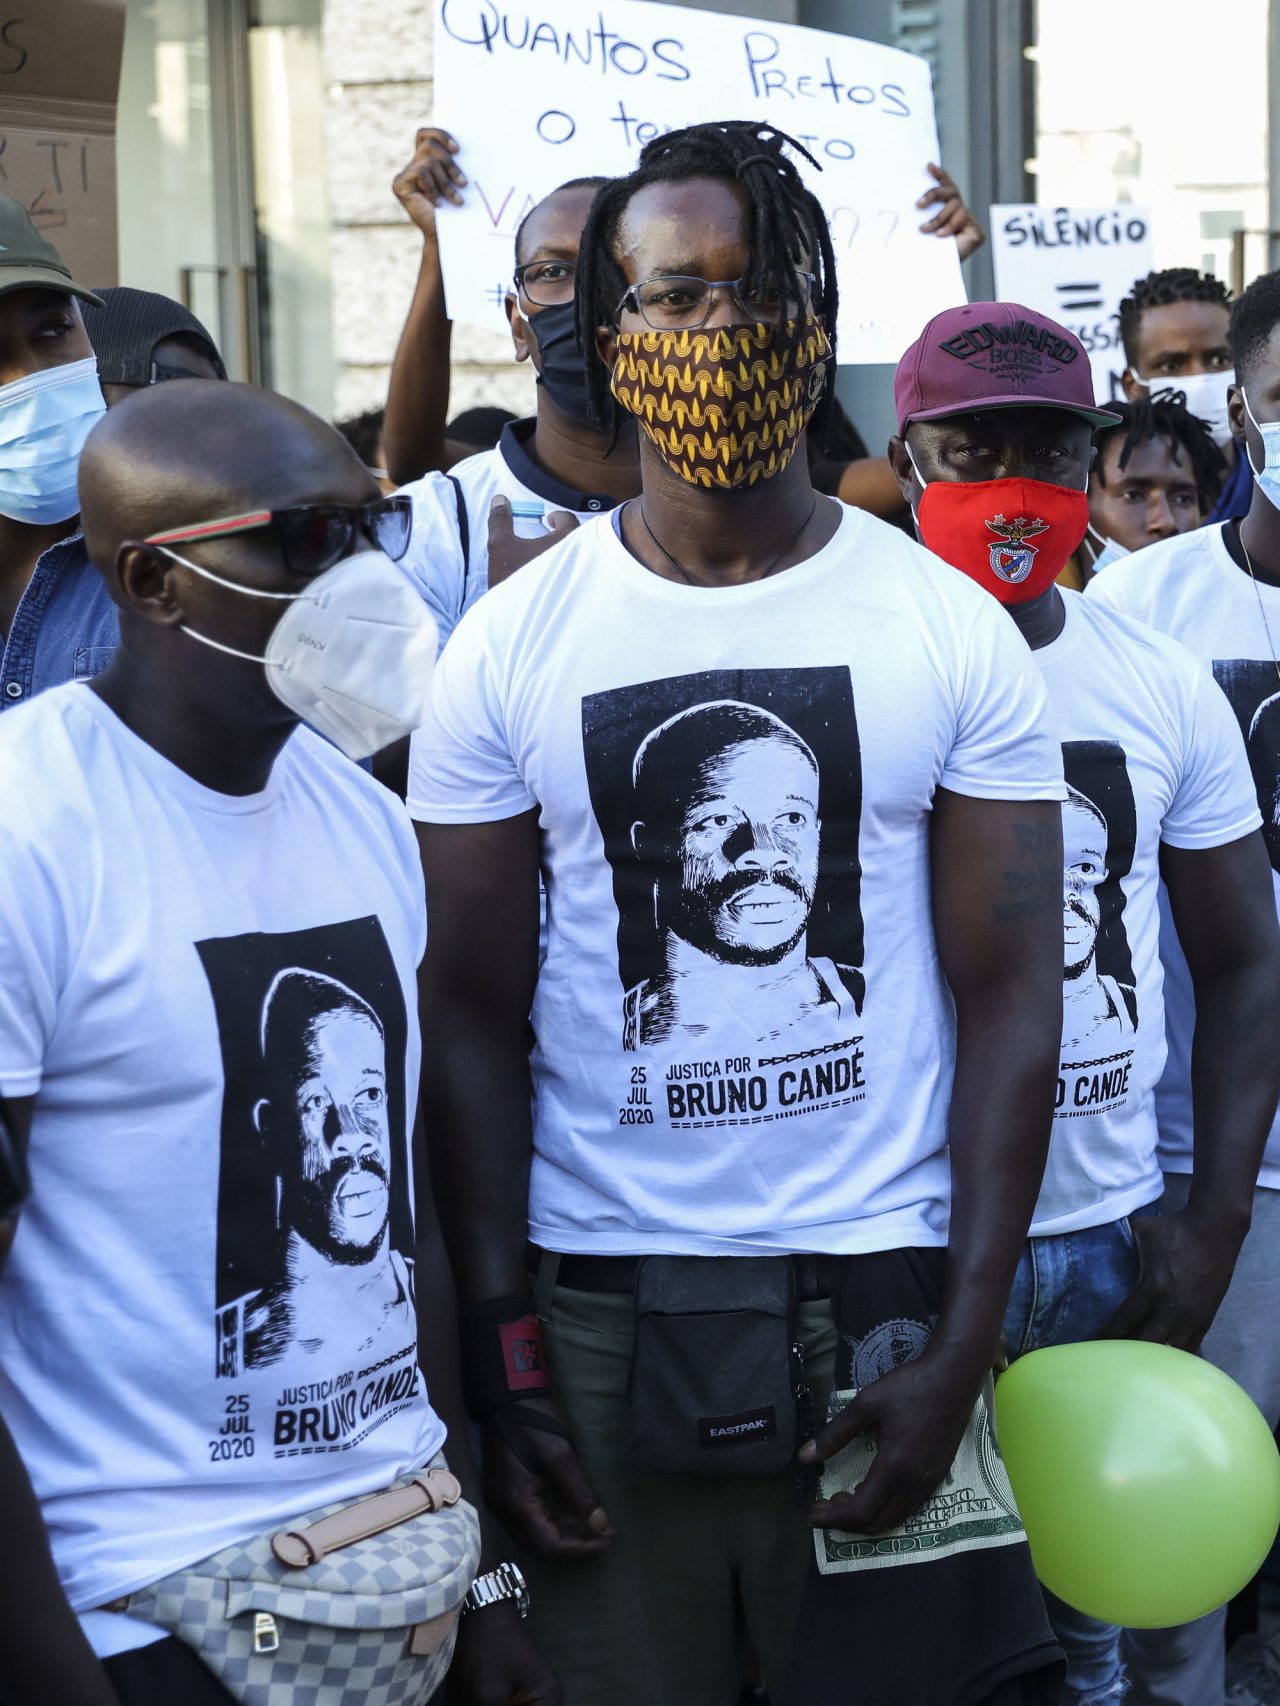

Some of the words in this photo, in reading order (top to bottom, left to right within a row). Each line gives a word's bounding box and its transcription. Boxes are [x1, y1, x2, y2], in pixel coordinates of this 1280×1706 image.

[939, 320, 1078, 364] EDWARD
[990, 349, 1041, 366] BOSS
[631, 1066, 646, 1084] 25
[666, 1061, 721, 1081] JUSTIÇA
[725, 1057, 751, 1074] POR
[666, 1076, 767, 1118] BRUNO
[778, 1047, 866, 1106] CANDÉ
[1073, 1059, 1132, 1107] CANDÉ
[627, 1087, 652, 1106] JUL
[619, 1108, 654, 1126] 2020
[334, 1371, 354, 1393] POR
[225, 1394, 250, 1414] 25
[219, 1416, 255, 1435] JUL
[274, 1389, 357, 1446] BRUNO
[208, 1437, 255, 1462] 2020
